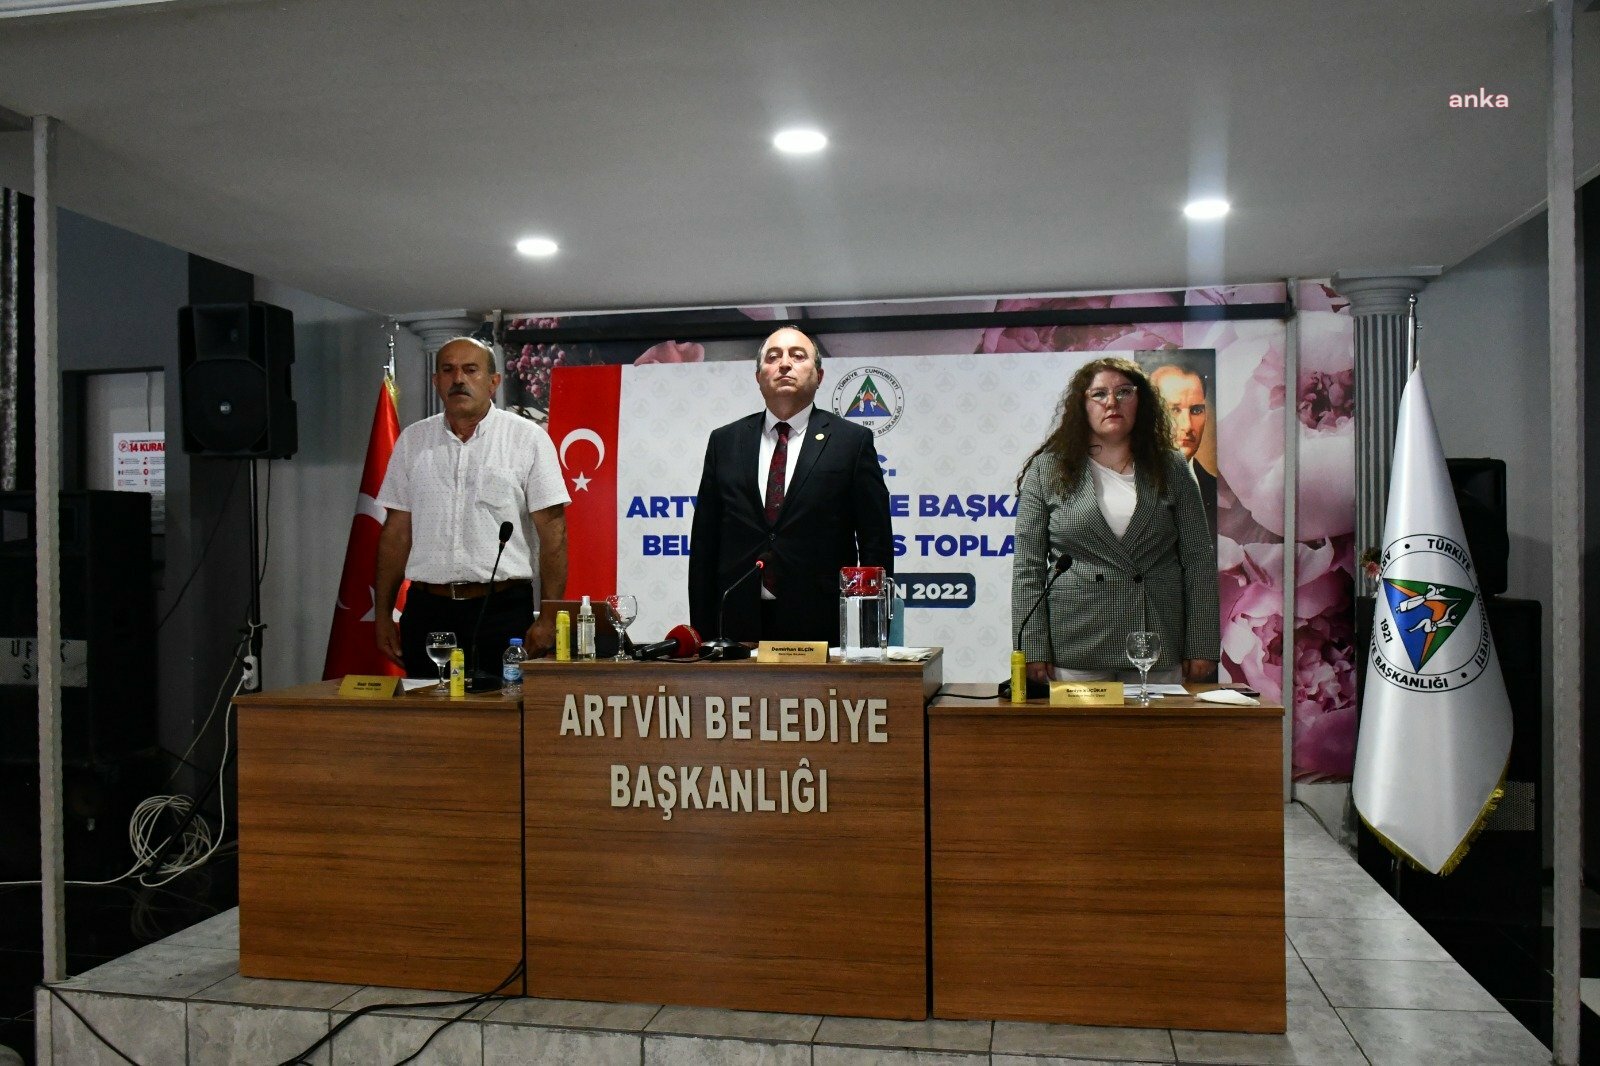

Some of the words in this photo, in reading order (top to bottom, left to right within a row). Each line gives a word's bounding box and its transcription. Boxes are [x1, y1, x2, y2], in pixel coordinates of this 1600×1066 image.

[129, 443, 139, 453] 14
[626, 495, 698, 519] ART
[642, 534, 692, 557] BEL
[914, 534, 1016, 557] TOPLA
[1427, 538, 1473, 573] TÜRKİYE
[911, 582, 969, 600] 2022
[1380, 618, 1394, 644] 1921
[1375, 656, 1449, 690] BAŞKANLIĞI
[559, 685, 691, 739] ARTVİN
[705, 688, 889, 743] BELEDİYE
[610, 757, 829, 821] BAŞKANLIĞI
